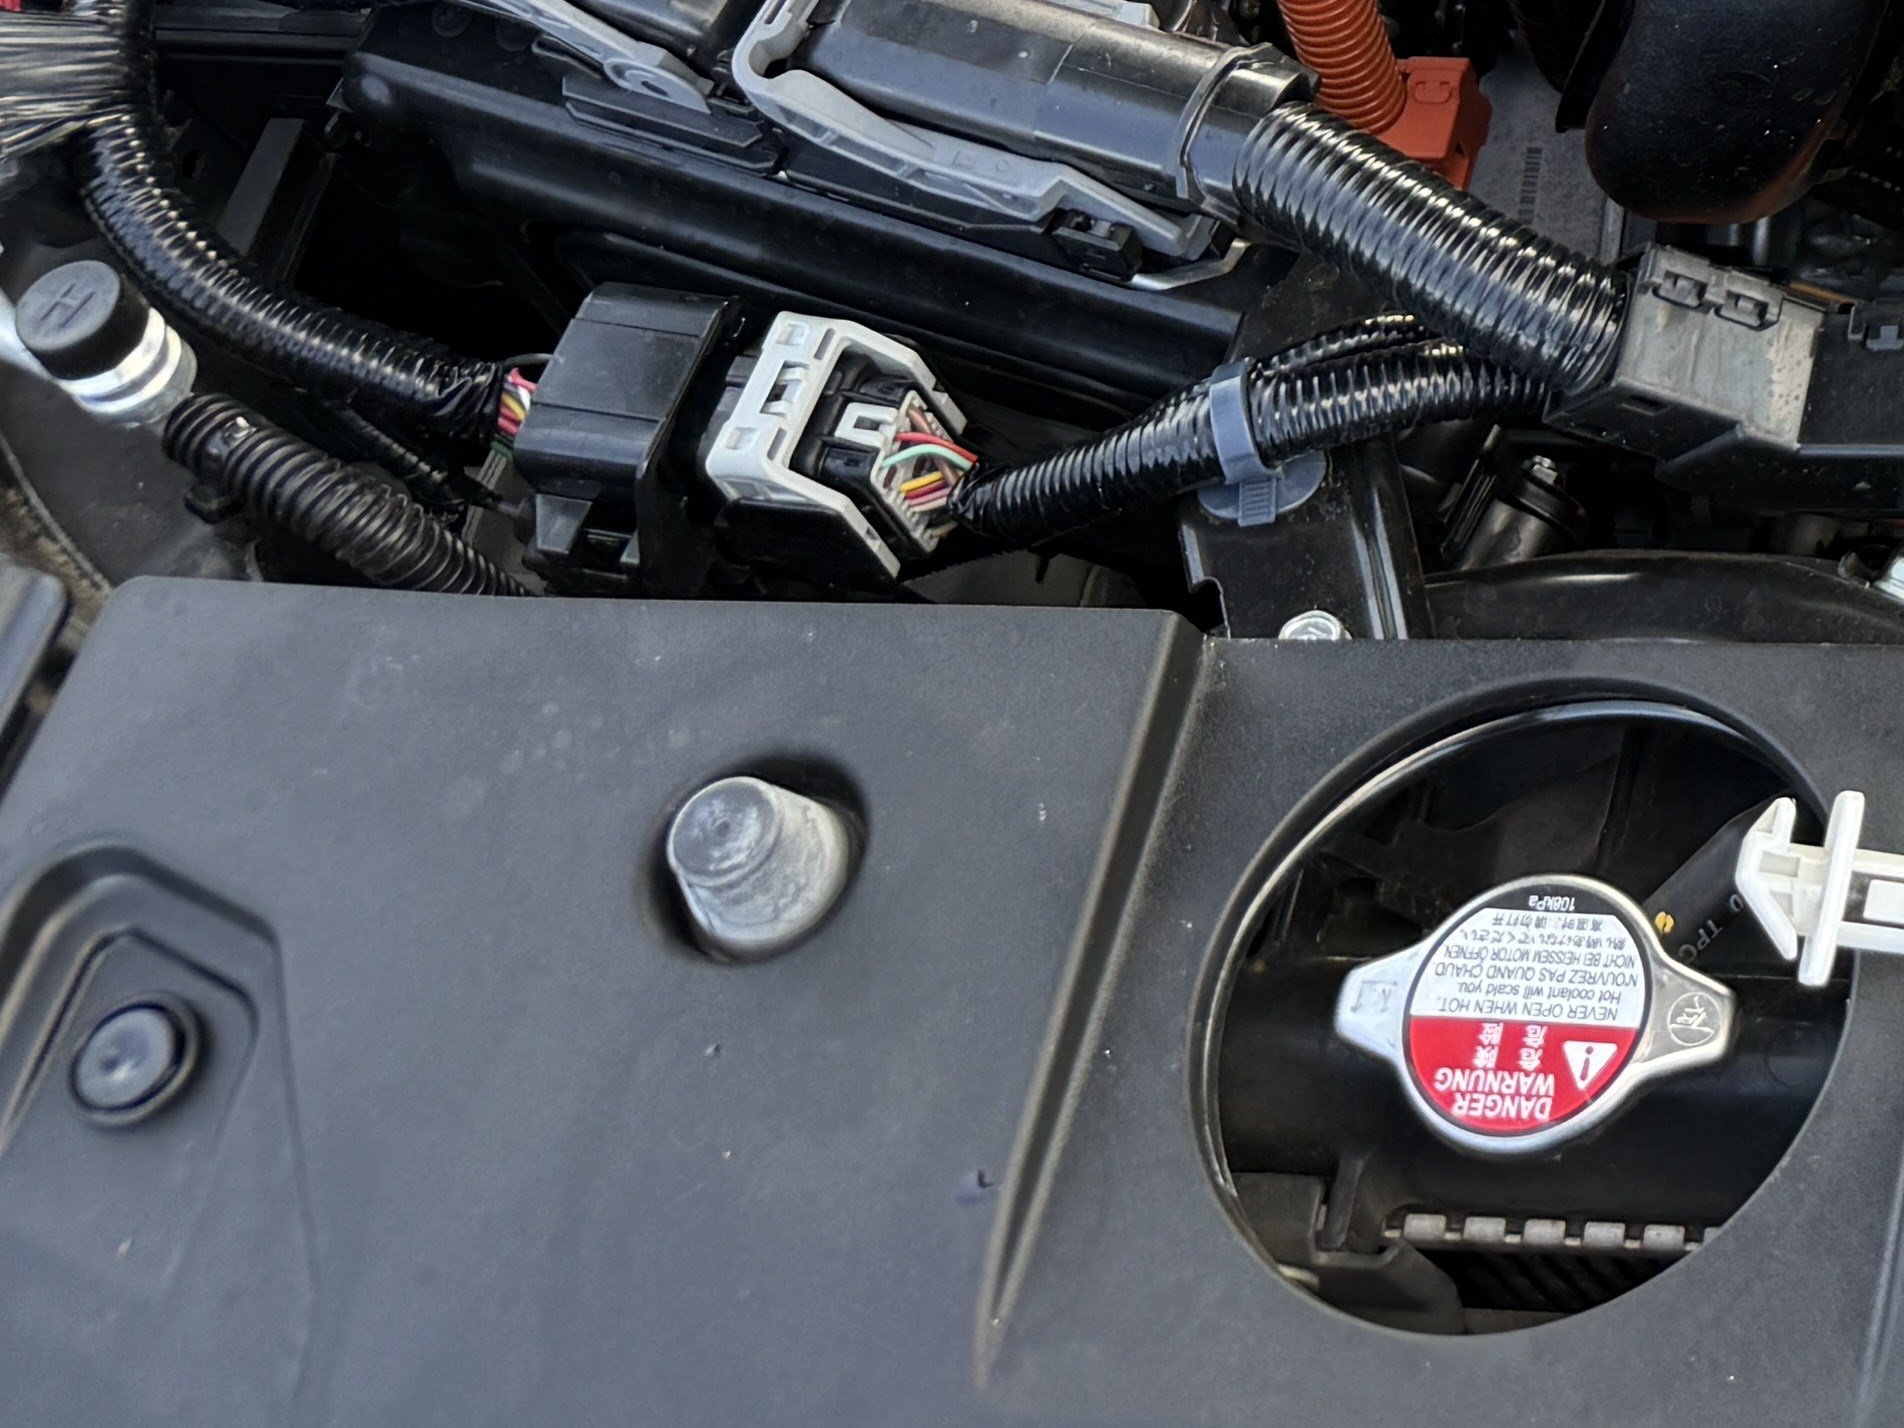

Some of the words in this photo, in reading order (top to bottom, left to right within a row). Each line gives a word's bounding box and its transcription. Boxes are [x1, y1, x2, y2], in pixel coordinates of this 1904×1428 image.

[1528, 895, 1575, 911] 108kPa
[1491, 948, 1531, 963] MOTOR
[1533, 950, 1581, 965] HEISSEM
[1584, 952, 1602, 965] BEI
[1604, 953, 1636, 969] NICHT
[1486, 965, 1536, 979] QUAND
[1538, 967, 1565, 981] PAS
[1569, 968, 1638, 986] N'OUVREZ
[1458, 981, 1484, 995] you.
[1487, 983, 1522, 996] scald
[1525, 986, 1544, 999] will
[1548, 988, 1596, 1002] coolant
[1438, 997, 1470, 1012] HOT.
[1600, 991, 1622, 1004] Hot
[1474, 1000, 1518, 1015] WHEN
[1522, 1002, 1563, 1018] OPEN
[1570, 1005, 1619, 1021] NEVER
[1435, 1068, 1555, 1095] WARNUNG
[1452, 1094, 1552, 1119] DANGER
